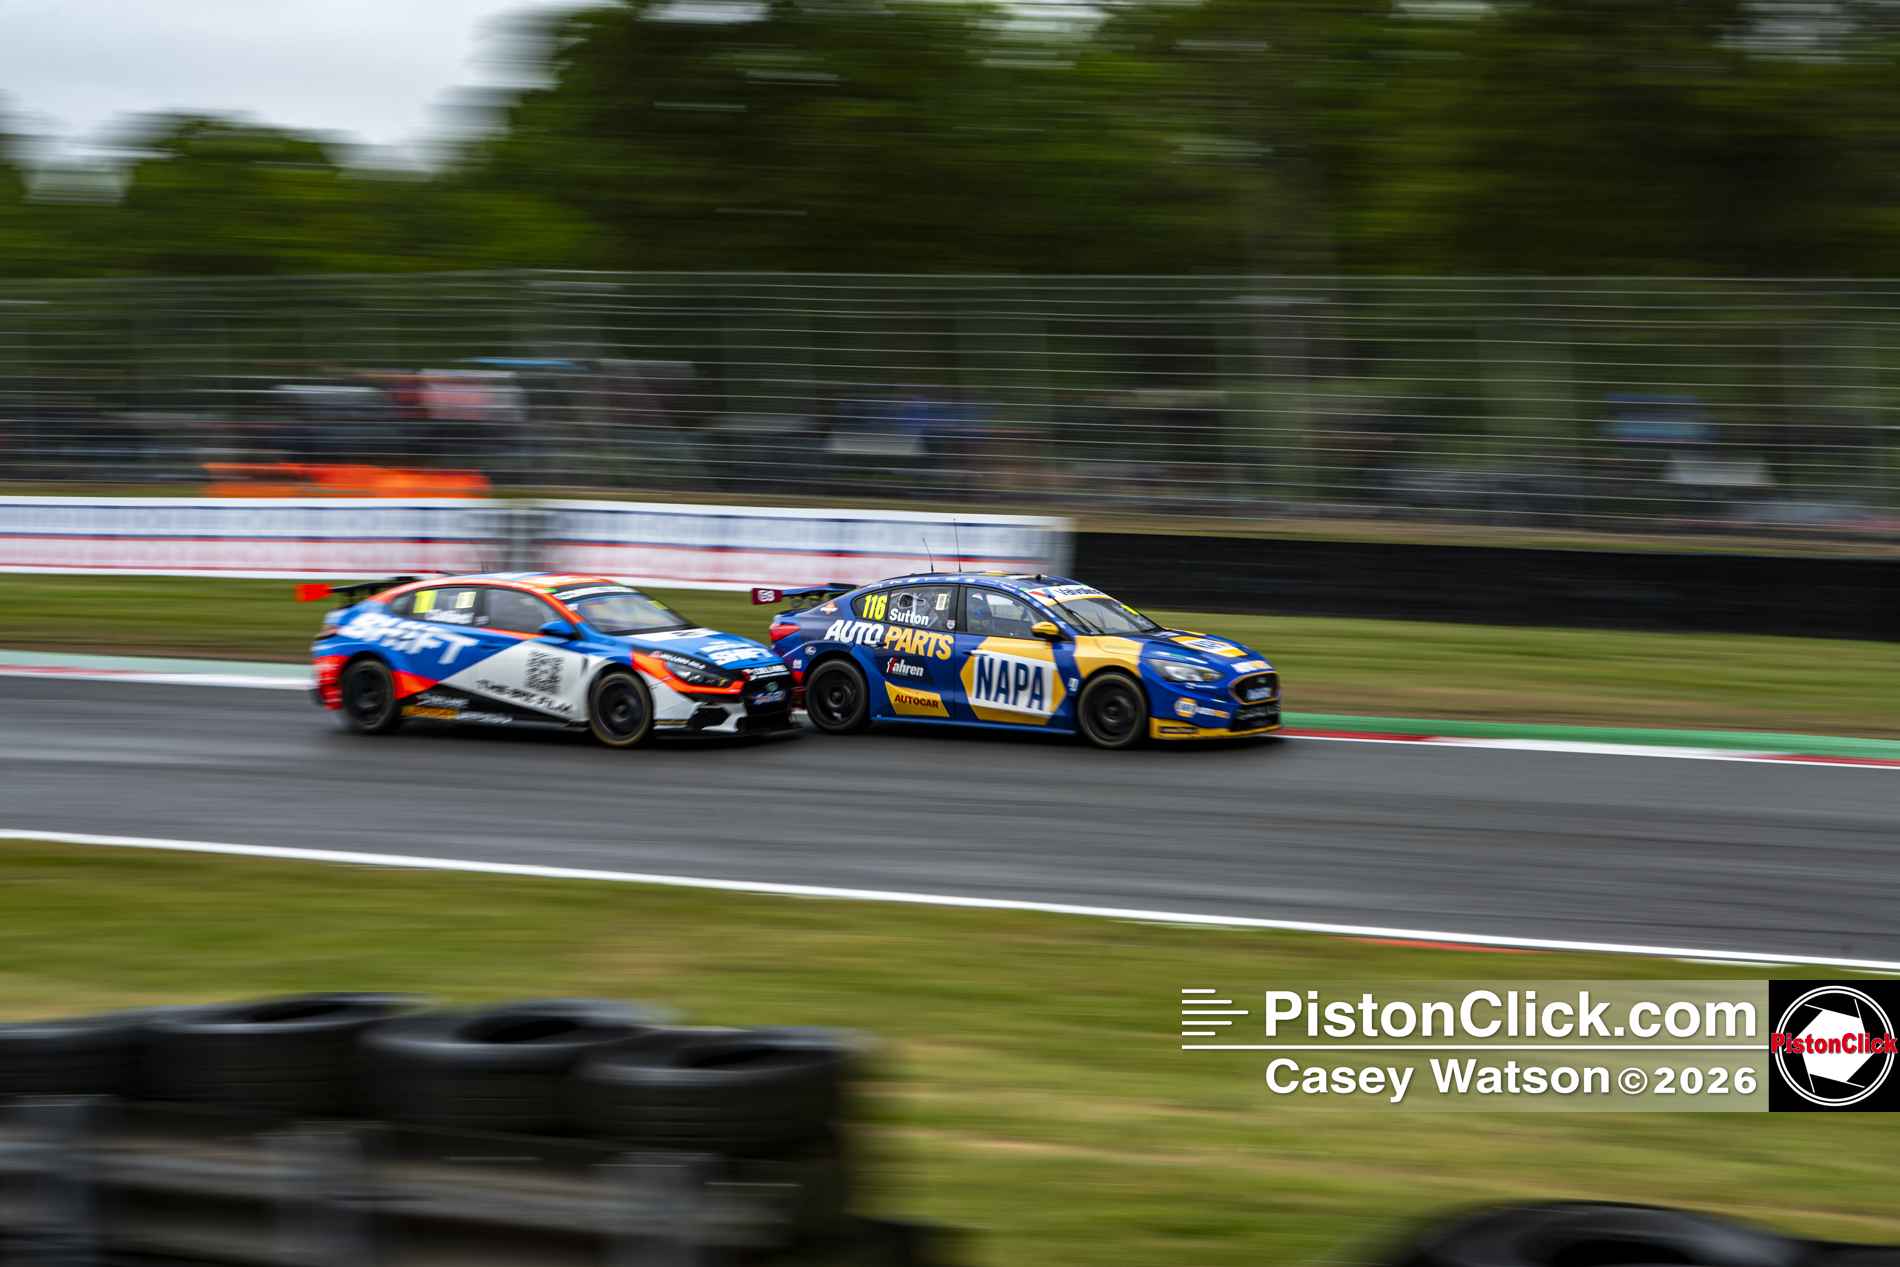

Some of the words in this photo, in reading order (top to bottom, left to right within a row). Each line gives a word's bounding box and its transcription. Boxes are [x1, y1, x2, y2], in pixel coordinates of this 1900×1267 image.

[863, 594, 887, 620] 116
[889, 608, 930, 626] Sutton
[824, 619, 884, 646] AUTO
[883, 626, 954, 660] PARTS
[886, 657, 924, 677] fahren
[975, 656, 1044, 711] NAPA
[894, 694, 939, 709] AUTOCAR
